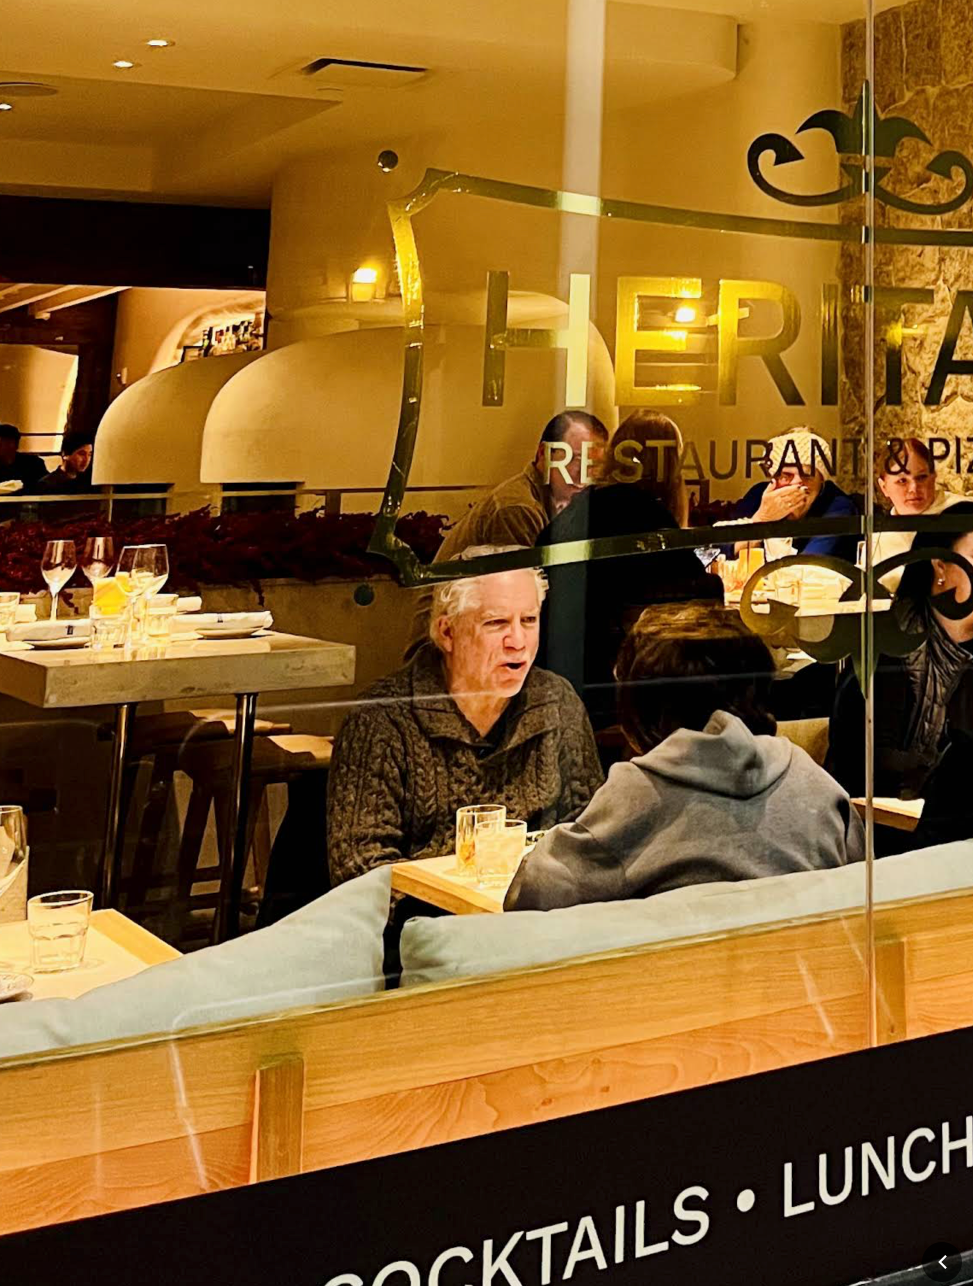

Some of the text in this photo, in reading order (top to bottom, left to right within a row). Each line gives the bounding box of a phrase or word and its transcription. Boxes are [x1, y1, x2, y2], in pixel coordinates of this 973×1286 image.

[543, 436, 867, 485] RESTAURANT
[886, 439, 909, 476] &
[324, 1185, 710, 1286] CKTAILS
